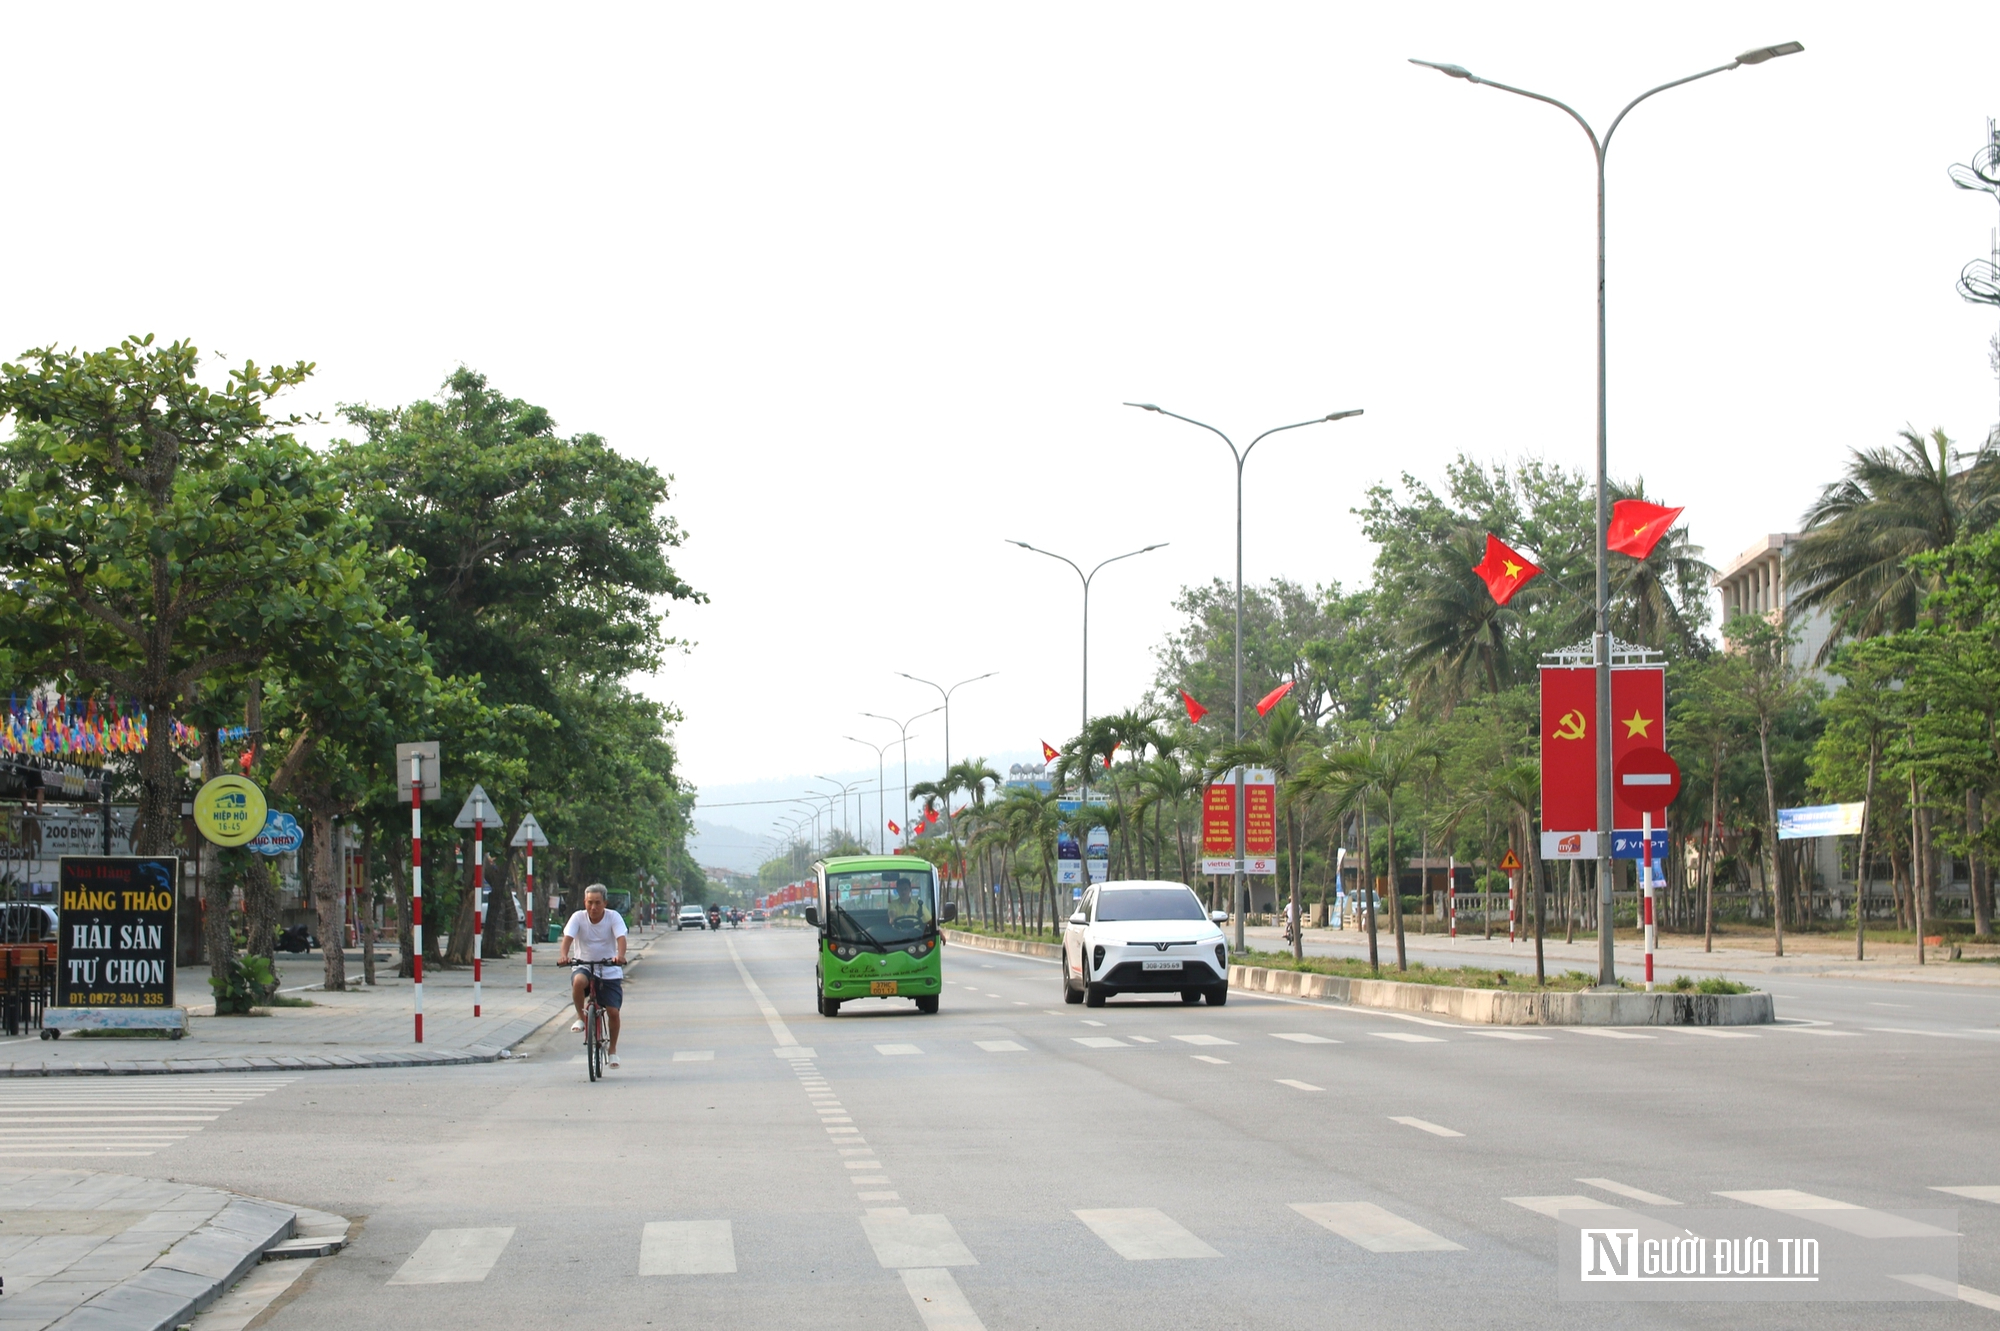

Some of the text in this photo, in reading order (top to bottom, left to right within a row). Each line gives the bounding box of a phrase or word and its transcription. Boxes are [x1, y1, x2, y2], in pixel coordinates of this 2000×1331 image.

[213, 811, 248, 821] HIỆP HỘI
[46, 826, 68, 838] 200
[218, 822, 241, 831] 16-45
[66, 865, 132, 882] Nhà Hàng
[64, 884, 172, 910] HẰNG THẢO
[72, 918, 162, 950] HẢI SẢN
[68, 957, 165, 988] TỰ CHỌN
[70, 993, 164, 1004] ĐT: 0972 341 335
